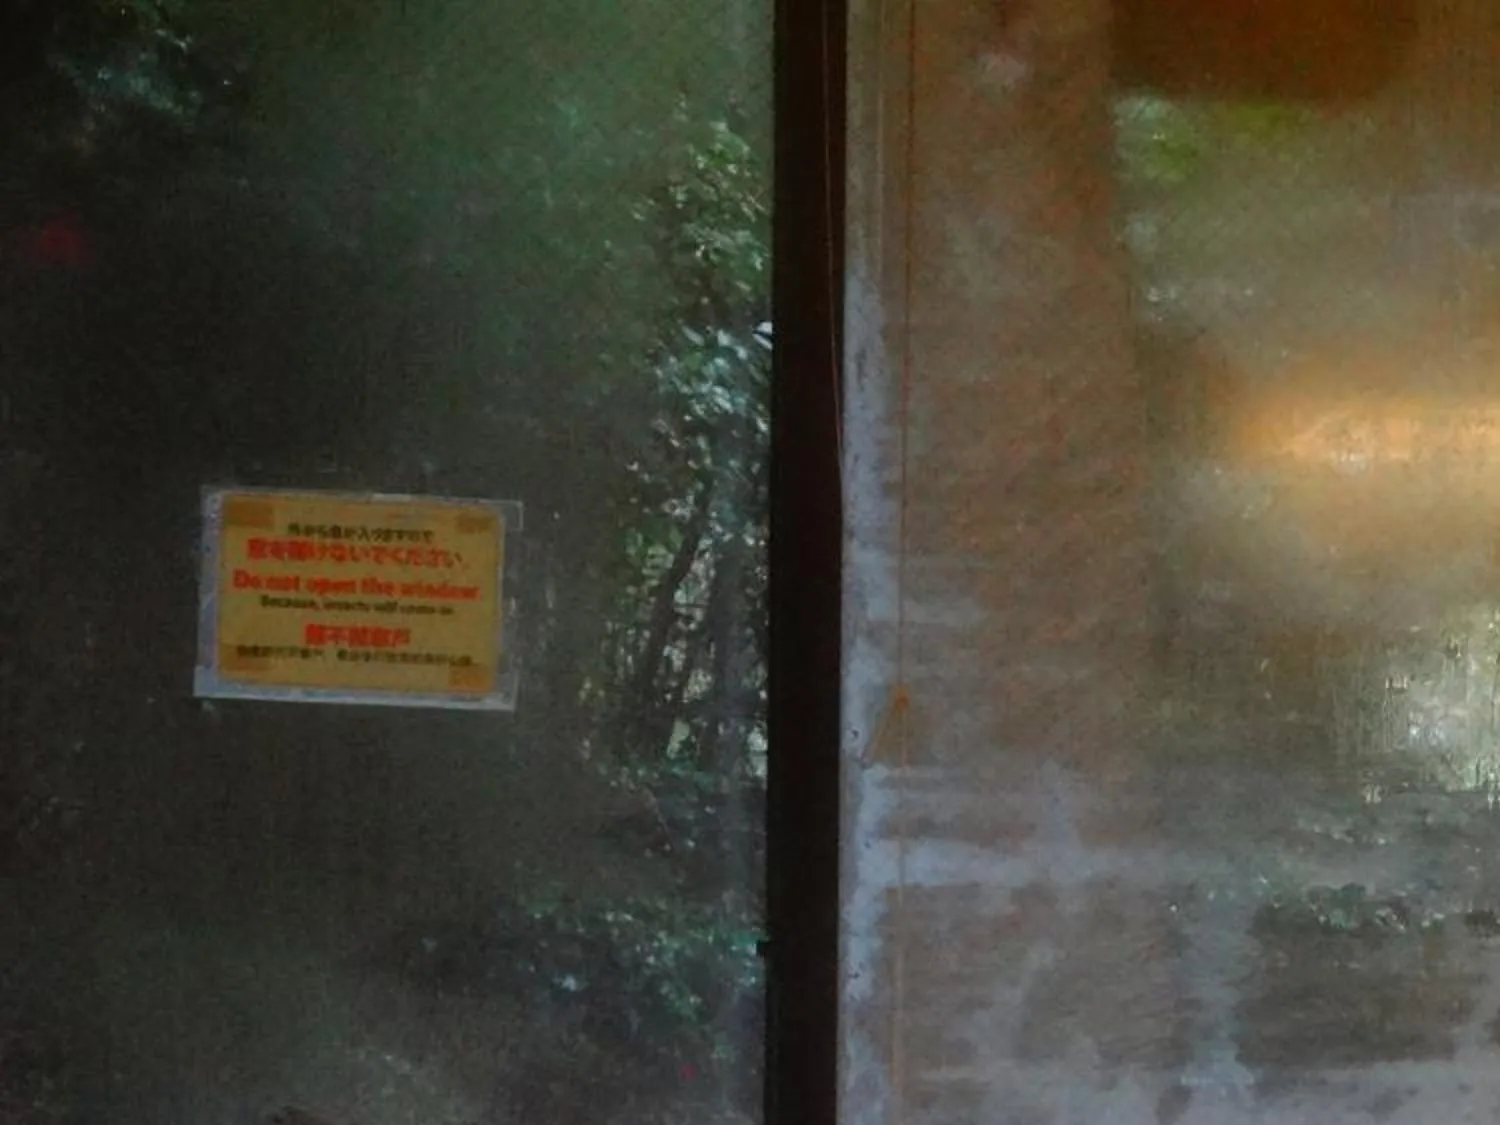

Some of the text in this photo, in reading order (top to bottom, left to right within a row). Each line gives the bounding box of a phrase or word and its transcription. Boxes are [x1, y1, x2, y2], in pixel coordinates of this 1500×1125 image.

[233, 570, 480, 602] Do not open the window
